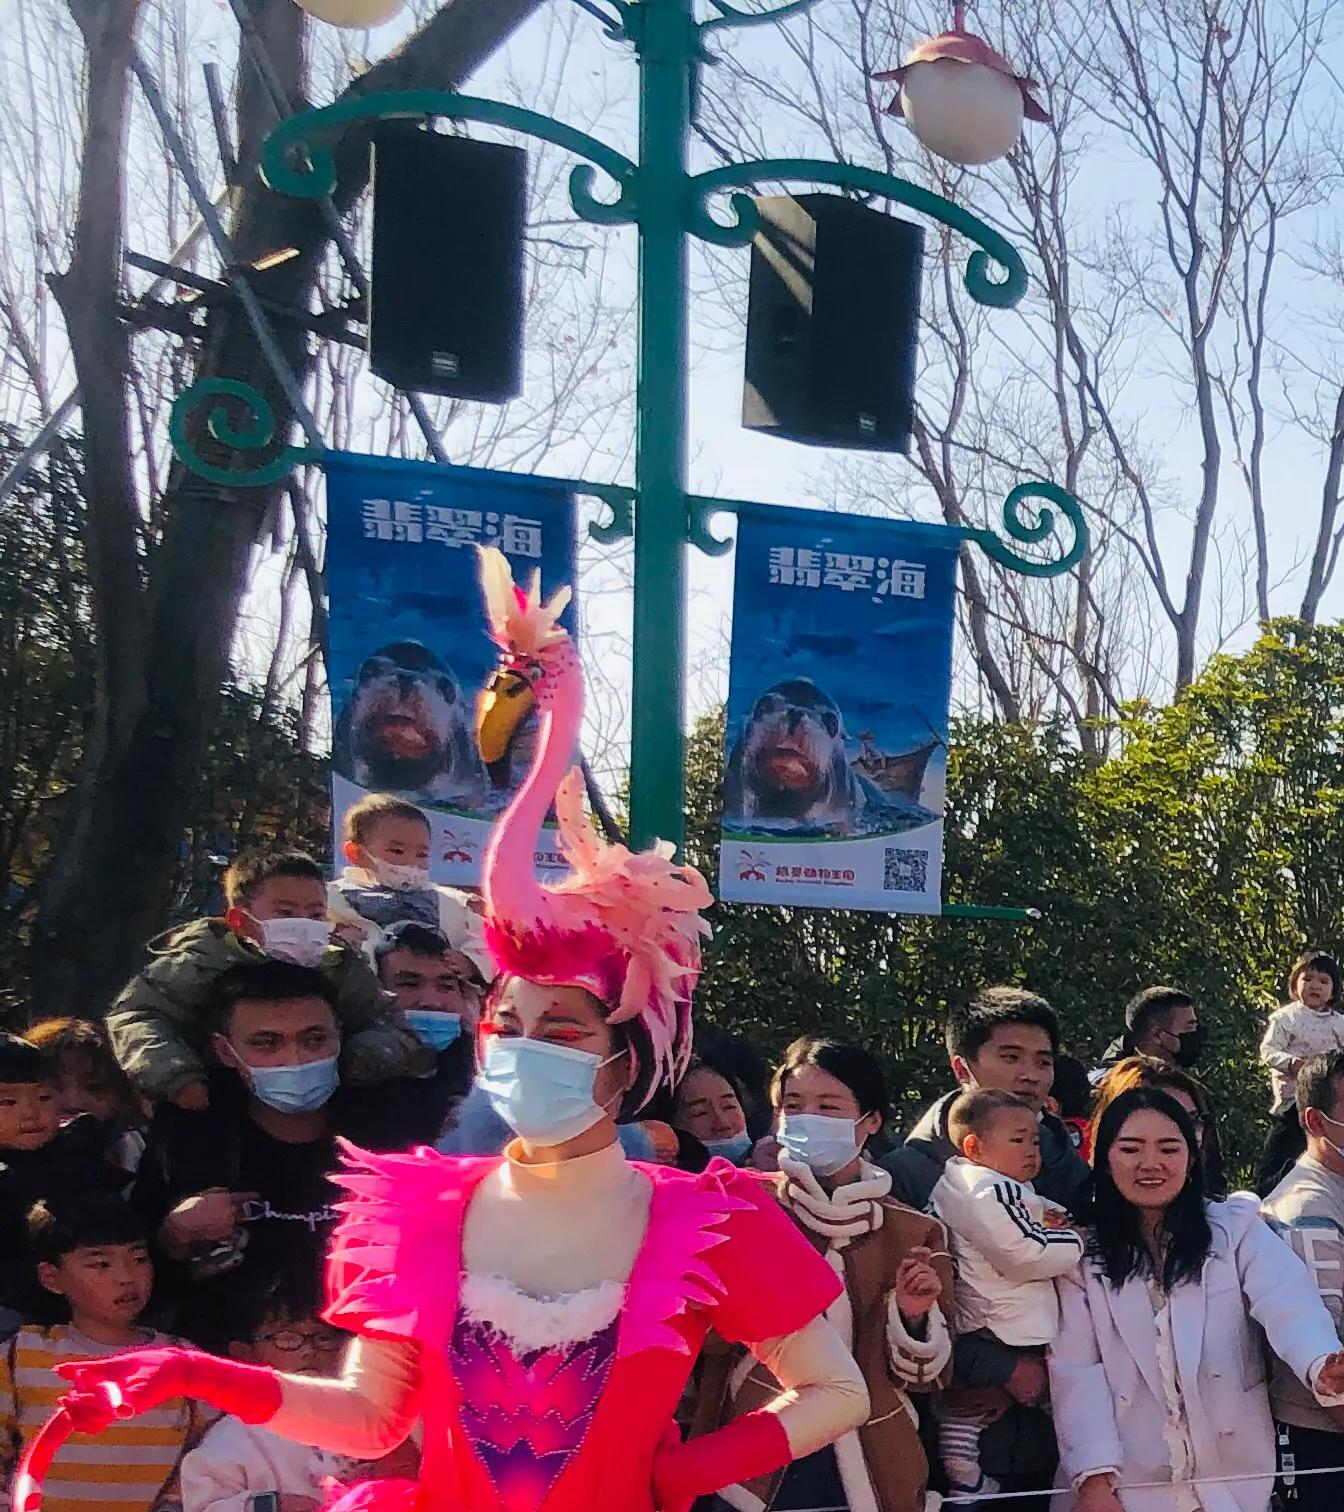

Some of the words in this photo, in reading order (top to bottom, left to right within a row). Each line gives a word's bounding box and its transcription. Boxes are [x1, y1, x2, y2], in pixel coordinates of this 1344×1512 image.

[362, 499, 542, 558] 翡翠海
[768, 546, 927, 604] 翡翠海
